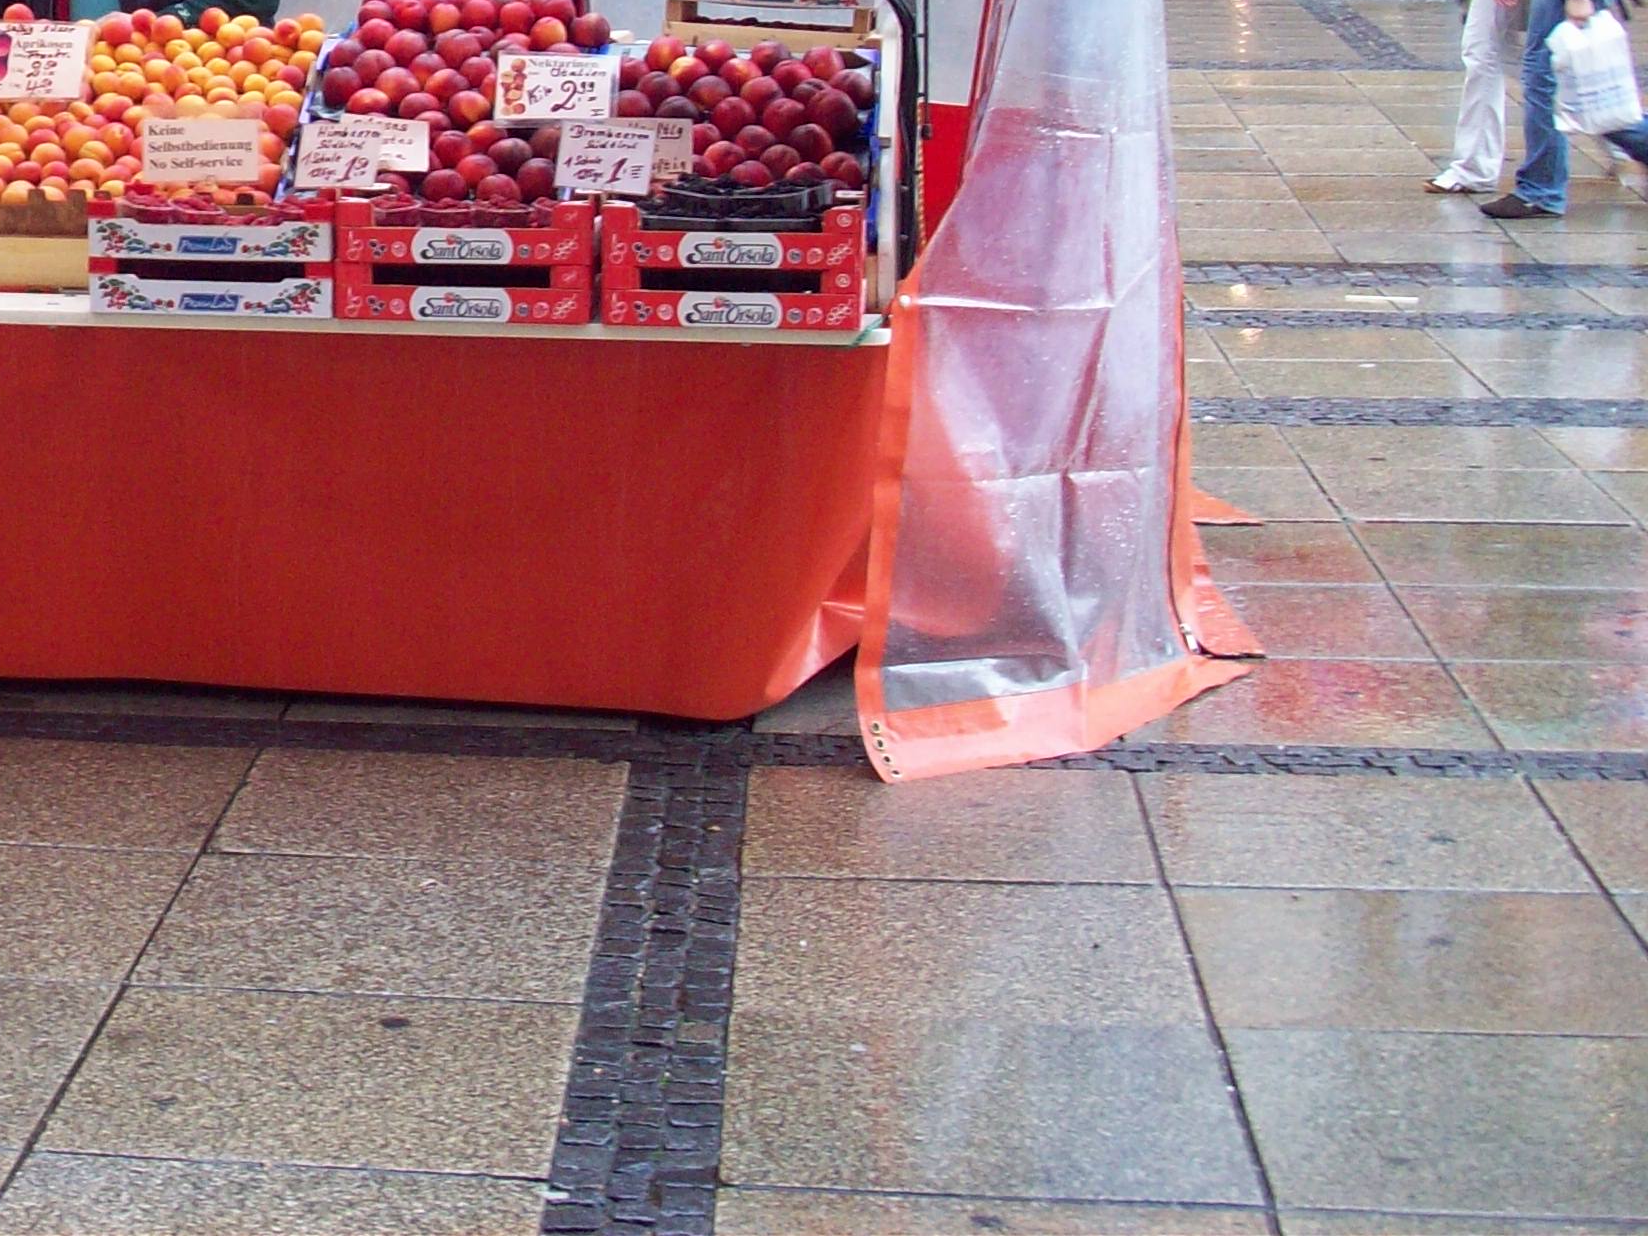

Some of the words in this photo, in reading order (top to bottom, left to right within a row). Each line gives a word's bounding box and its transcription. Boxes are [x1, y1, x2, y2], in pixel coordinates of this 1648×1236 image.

[528, 58, 600, 68] Nektarinen
[148, 125, 186, 136] Keine
[570, 124, 650, 140] Brombeeren
[148, 140, 253, 153] Selbstbedienung
[150, 159, 167, 169] No
[171, 156, 244, 169] Self-service
